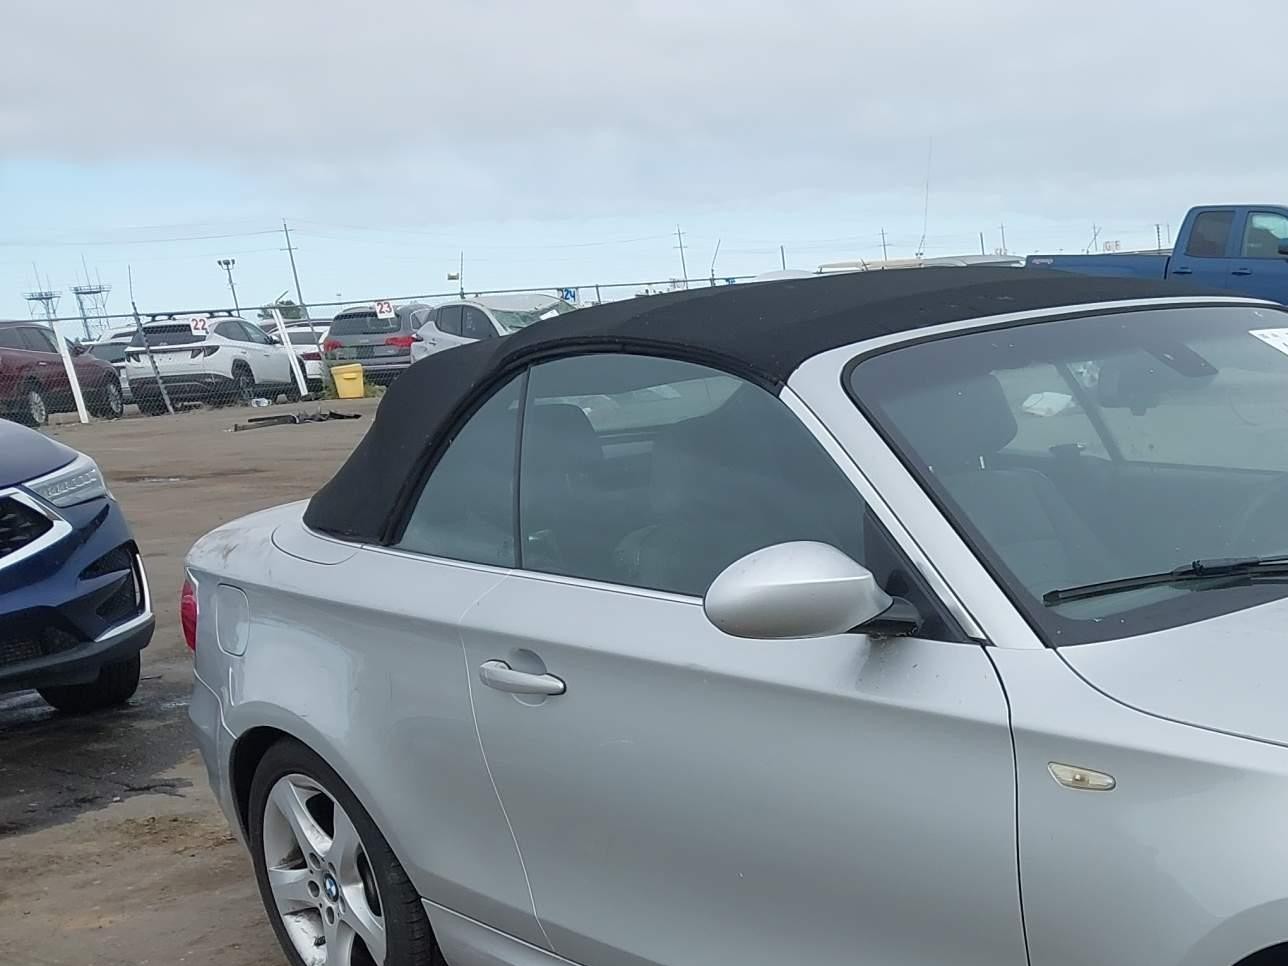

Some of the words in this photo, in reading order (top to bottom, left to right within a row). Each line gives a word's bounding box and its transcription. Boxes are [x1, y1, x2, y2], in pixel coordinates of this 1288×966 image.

[564, 288, 576, 302] 24
[376, 301, 393, 314] 23
[191, 318, 207, 331] 22
